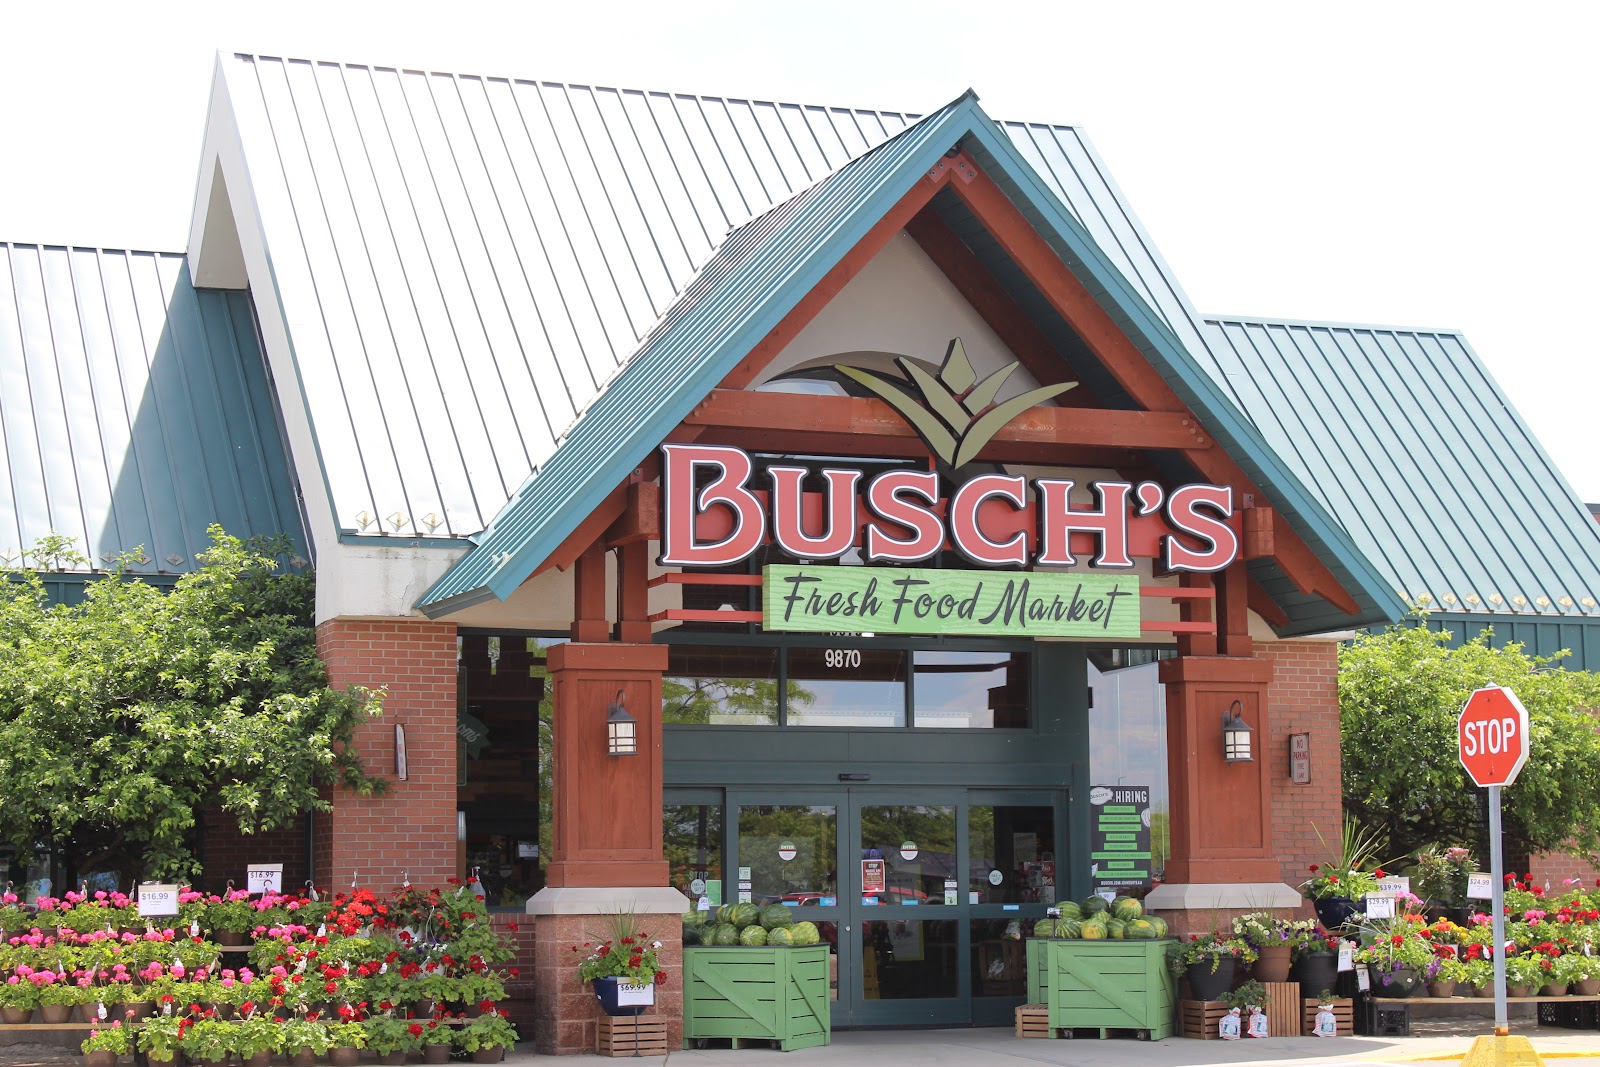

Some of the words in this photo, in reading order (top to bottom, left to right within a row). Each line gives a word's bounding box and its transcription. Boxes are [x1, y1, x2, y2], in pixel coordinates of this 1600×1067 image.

[659, 443, 1239, 572] BUSCH'S
[783, 572, 883, 622] Fresh
[892, 575, 983, 624] Food
[978, 578, 1133, 629] Market
[824, 648, 862, 668] 9870
[1464, 717, 1516, 756] STOP
[1296, 739, 1304, 749] NO
[1293, 751, 1308, 760] PARKING
[1115, 790, 1147, 803] HIRING
[249, 871, 274, 879] $16.99
[689, 870, 709, 881] STOP
[1470, 878, 1490, 886] $24.99
[141, 892, 169, 901] $16.99
